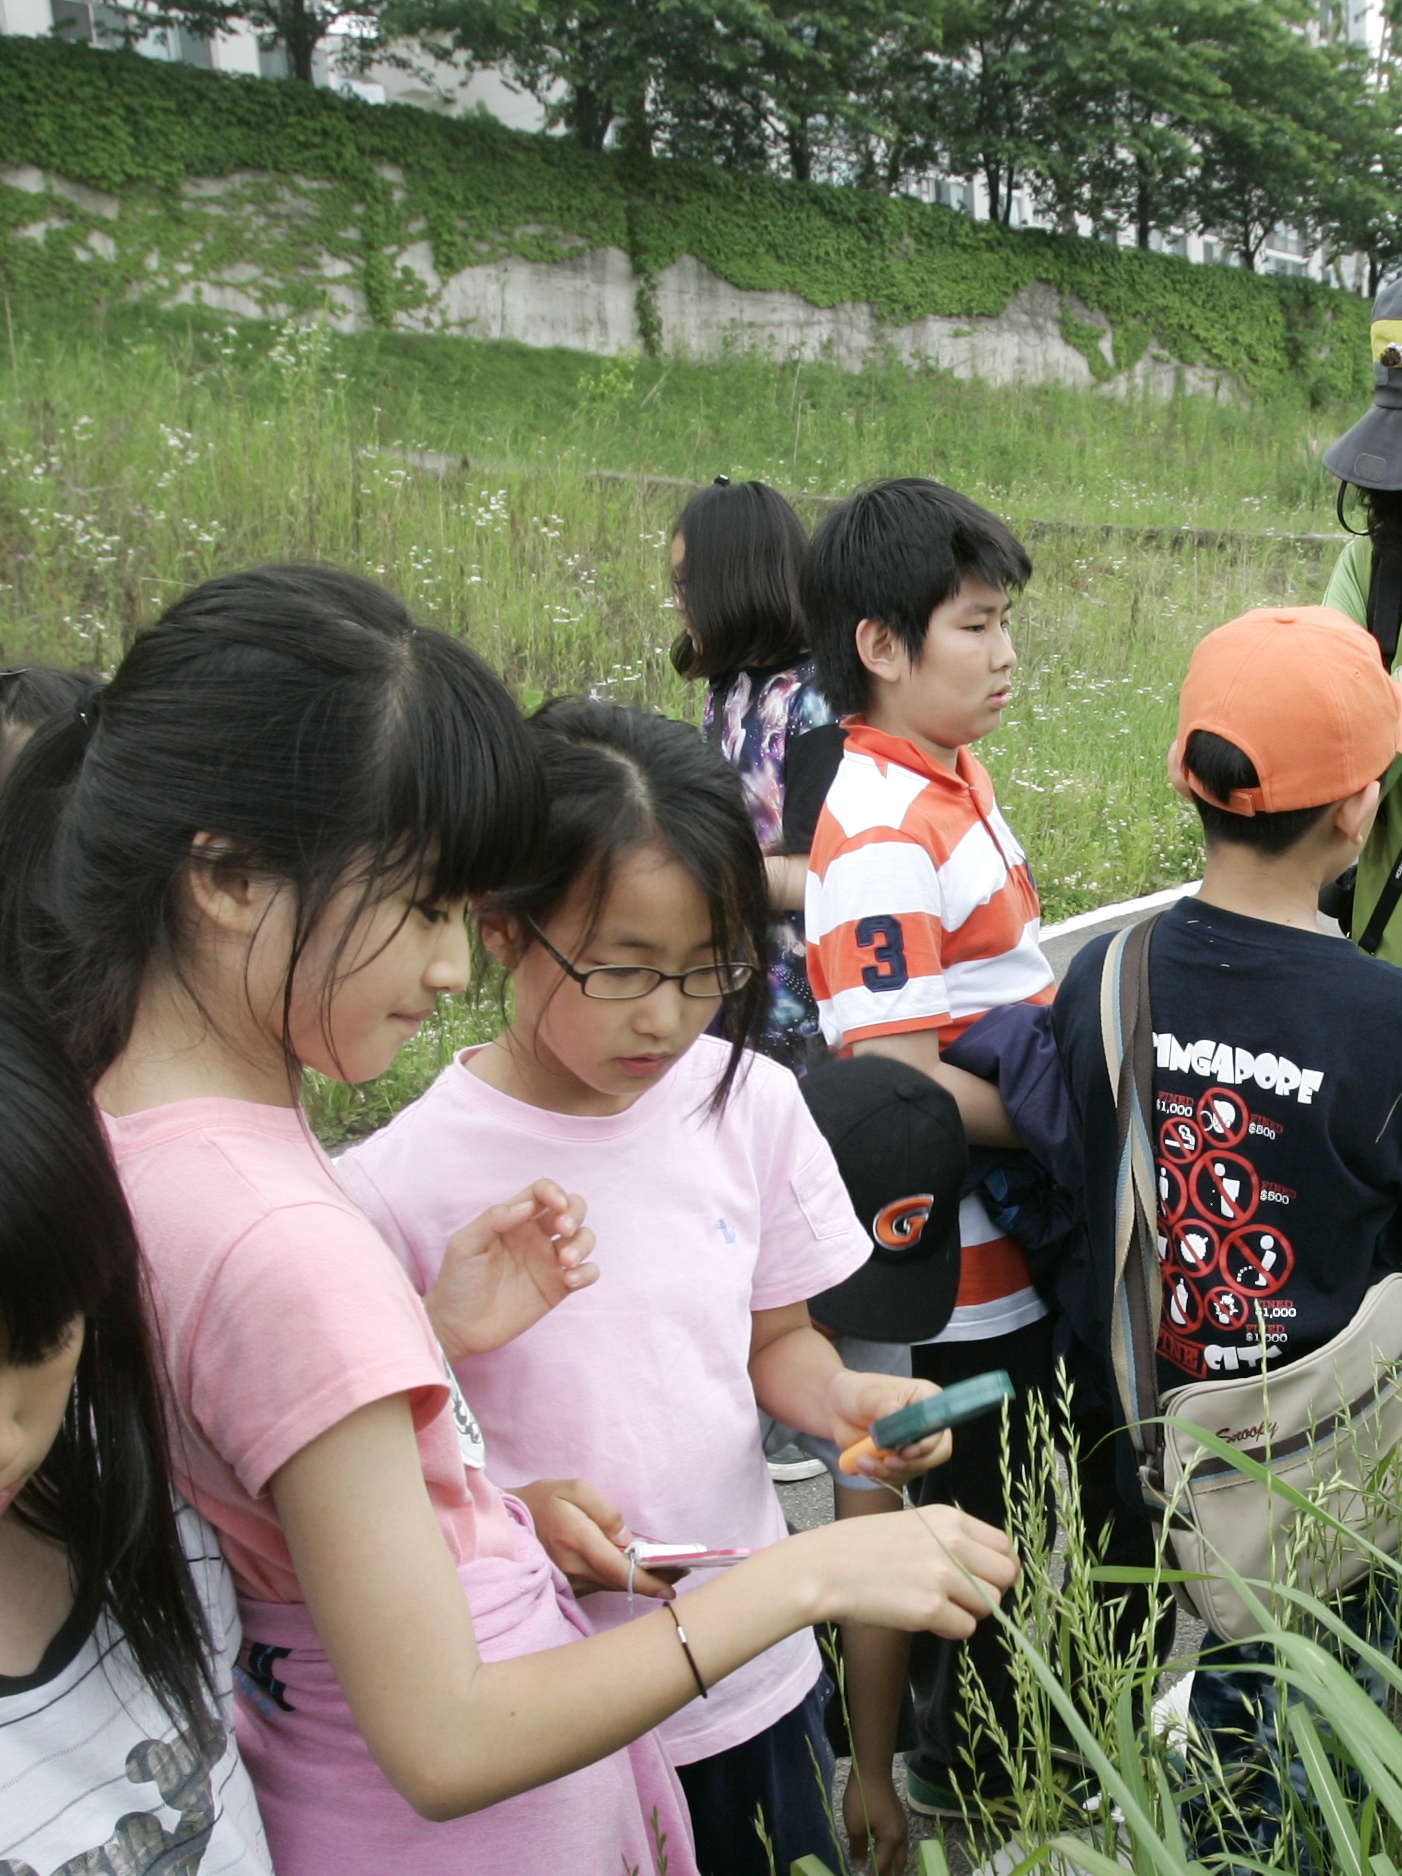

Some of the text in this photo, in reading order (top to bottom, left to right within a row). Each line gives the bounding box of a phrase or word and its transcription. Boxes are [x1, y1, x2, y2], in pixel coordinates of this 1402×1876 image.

[855, 914, 909, 993] 3
[1152, 1031, 1325, 1105] INGAPORE
[1259, 1188, 1290, 1206] $500
[1258, 1299, 1294, 1309] INED
[1245, 1323, 1286, 1335] FIED
[1159, 1326, 1199, 1371] INE
